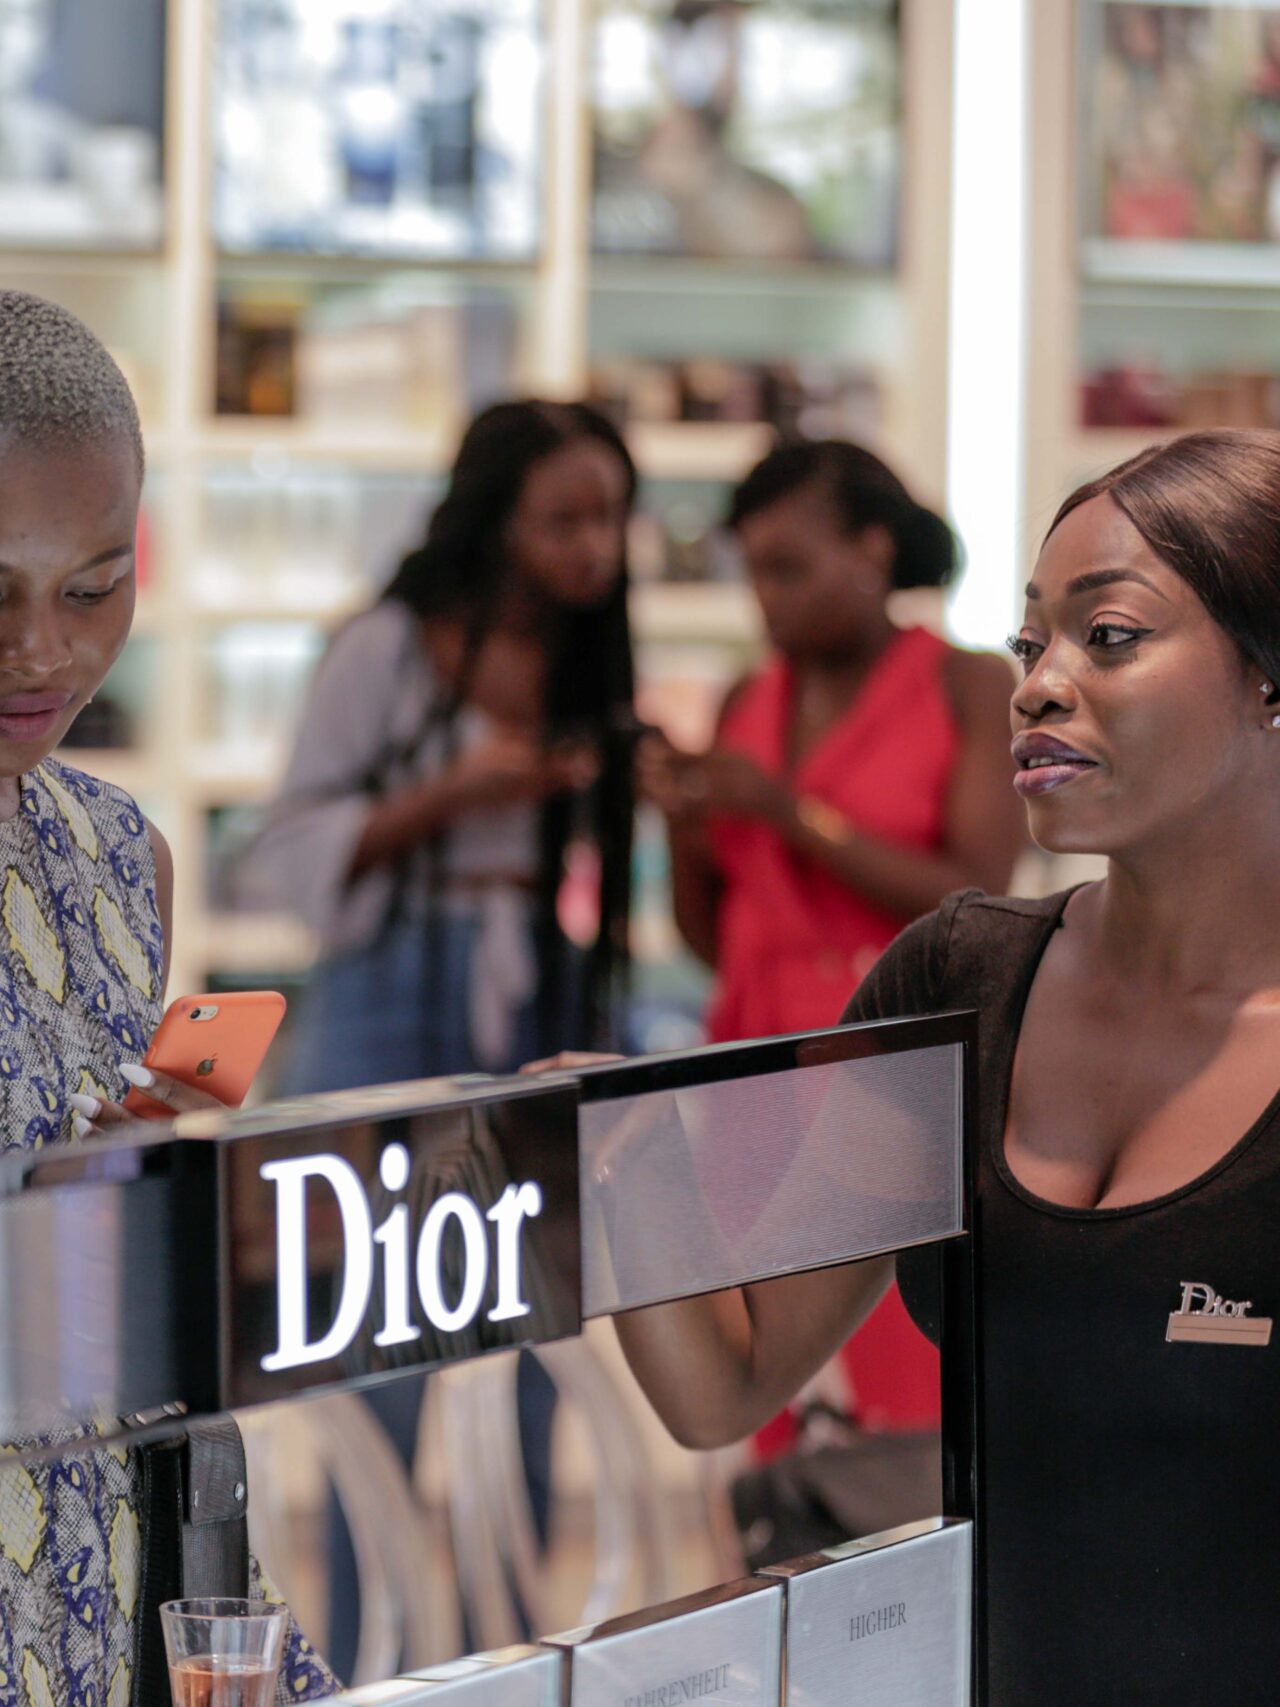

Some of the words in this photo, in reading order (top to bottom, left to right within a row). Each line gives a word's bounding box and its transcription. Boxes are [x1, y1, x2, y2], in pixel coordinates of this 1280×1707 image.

[260, 1142, 543, 1372] Dior
[1175, 1281, 1253, 1318] Dior
[849, 1602, 907, 1641] HIGHER
